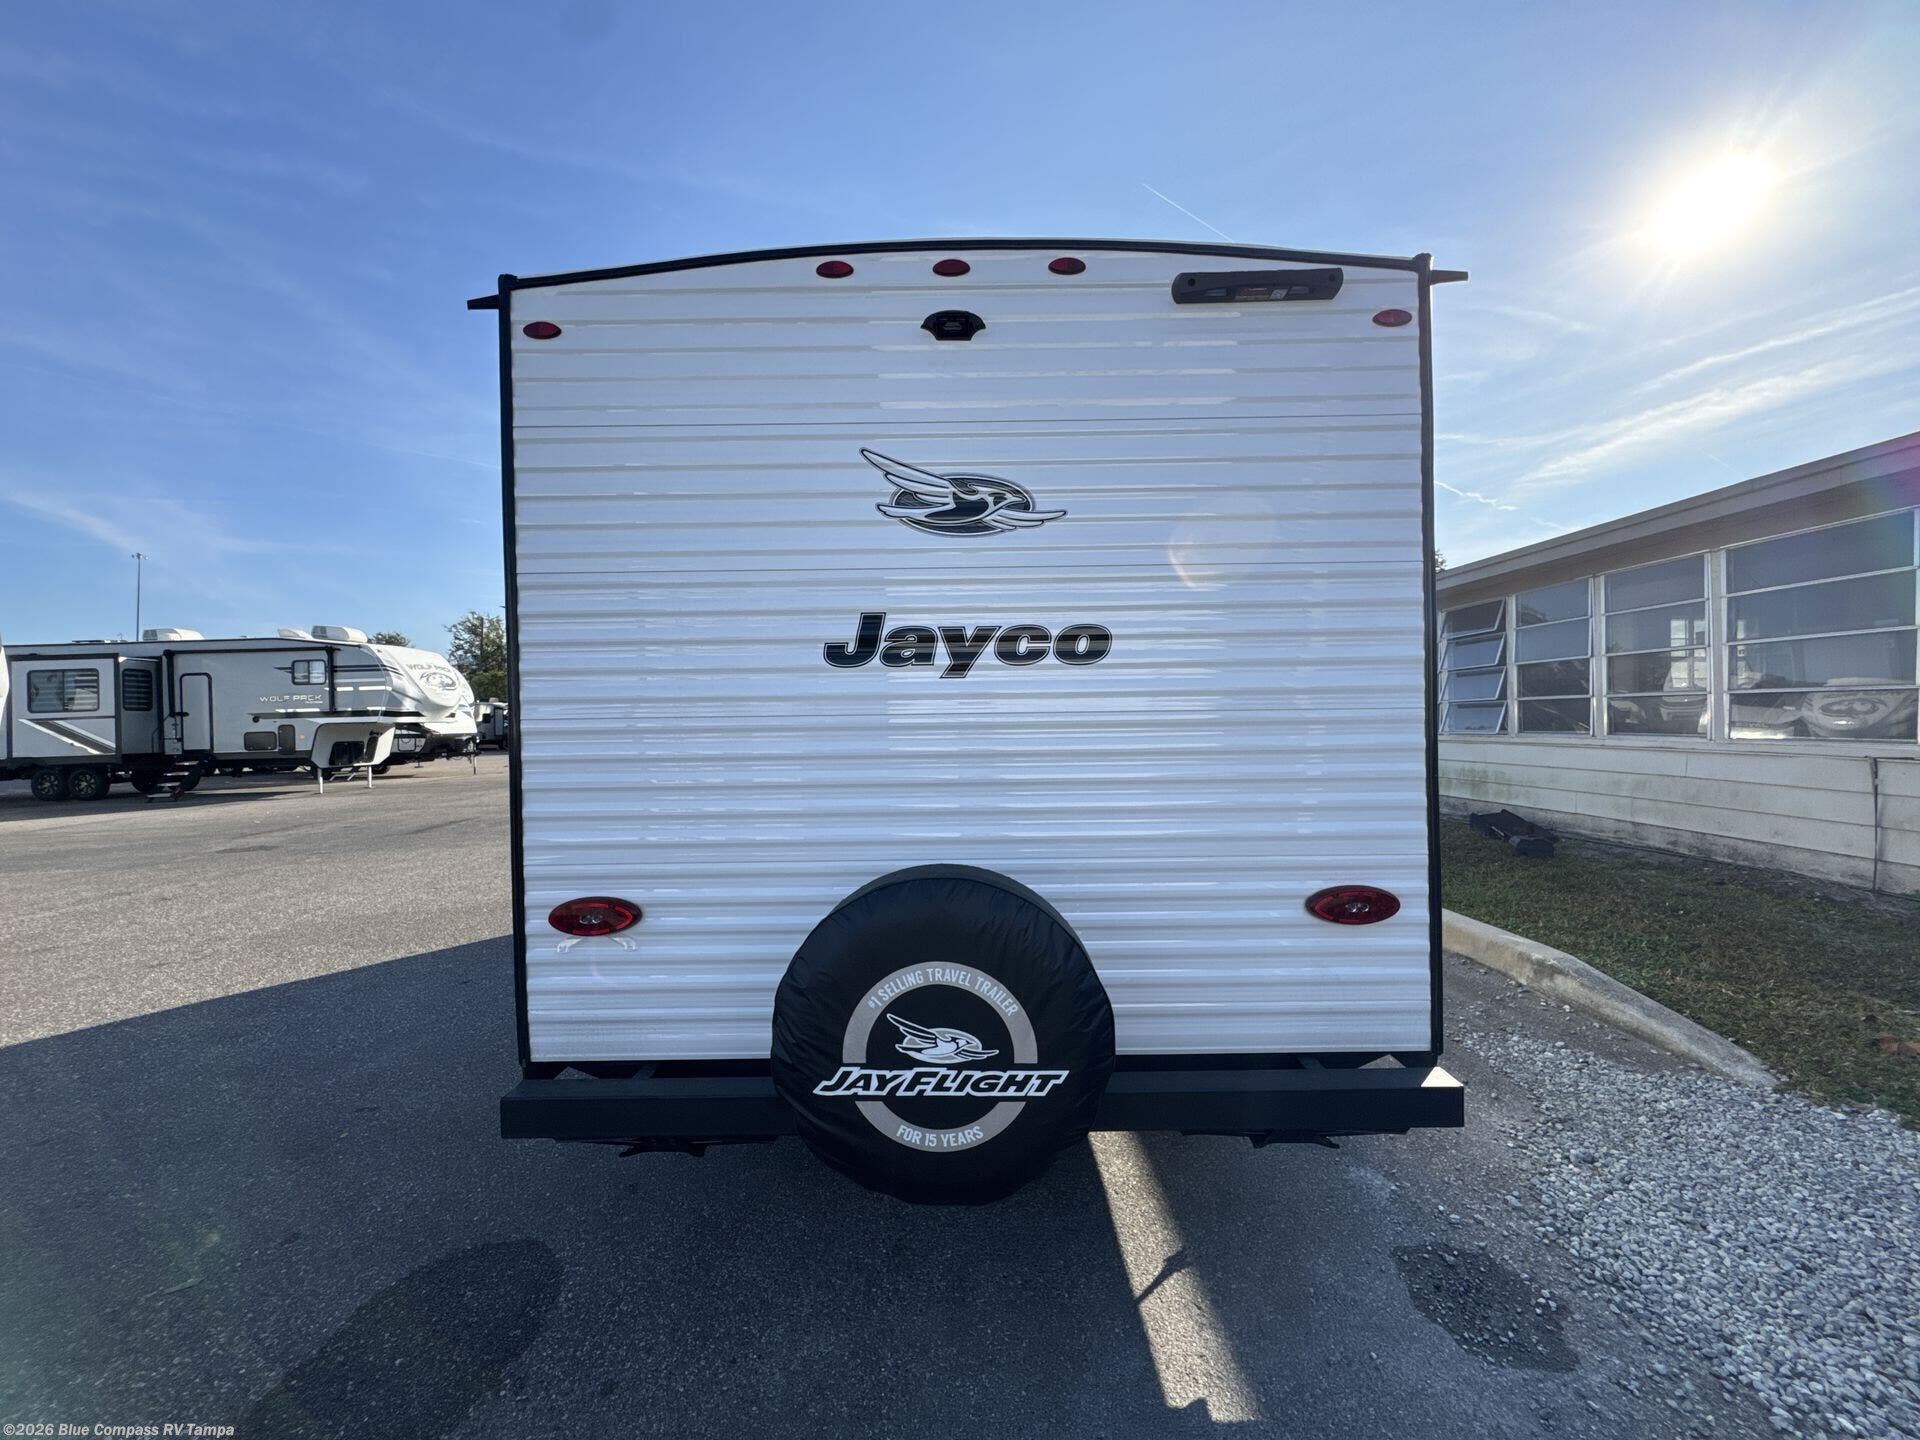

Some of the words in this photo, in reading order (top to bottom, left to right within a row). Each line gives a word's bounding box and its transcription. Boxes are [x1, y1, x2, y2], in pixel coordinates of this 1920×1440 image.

[823, 612, 1113, 679] Jayco
[878, 970, 924, 1001] SELLING
[926, 968, 971, 987] TRAVEL
[975, 976, 1019, 1017] TRAILER
[896, 1124, 921, 1144] FOR
[924, 1132, 937, 1147] 15
[940, 1125, 984, 1148] YEARS
